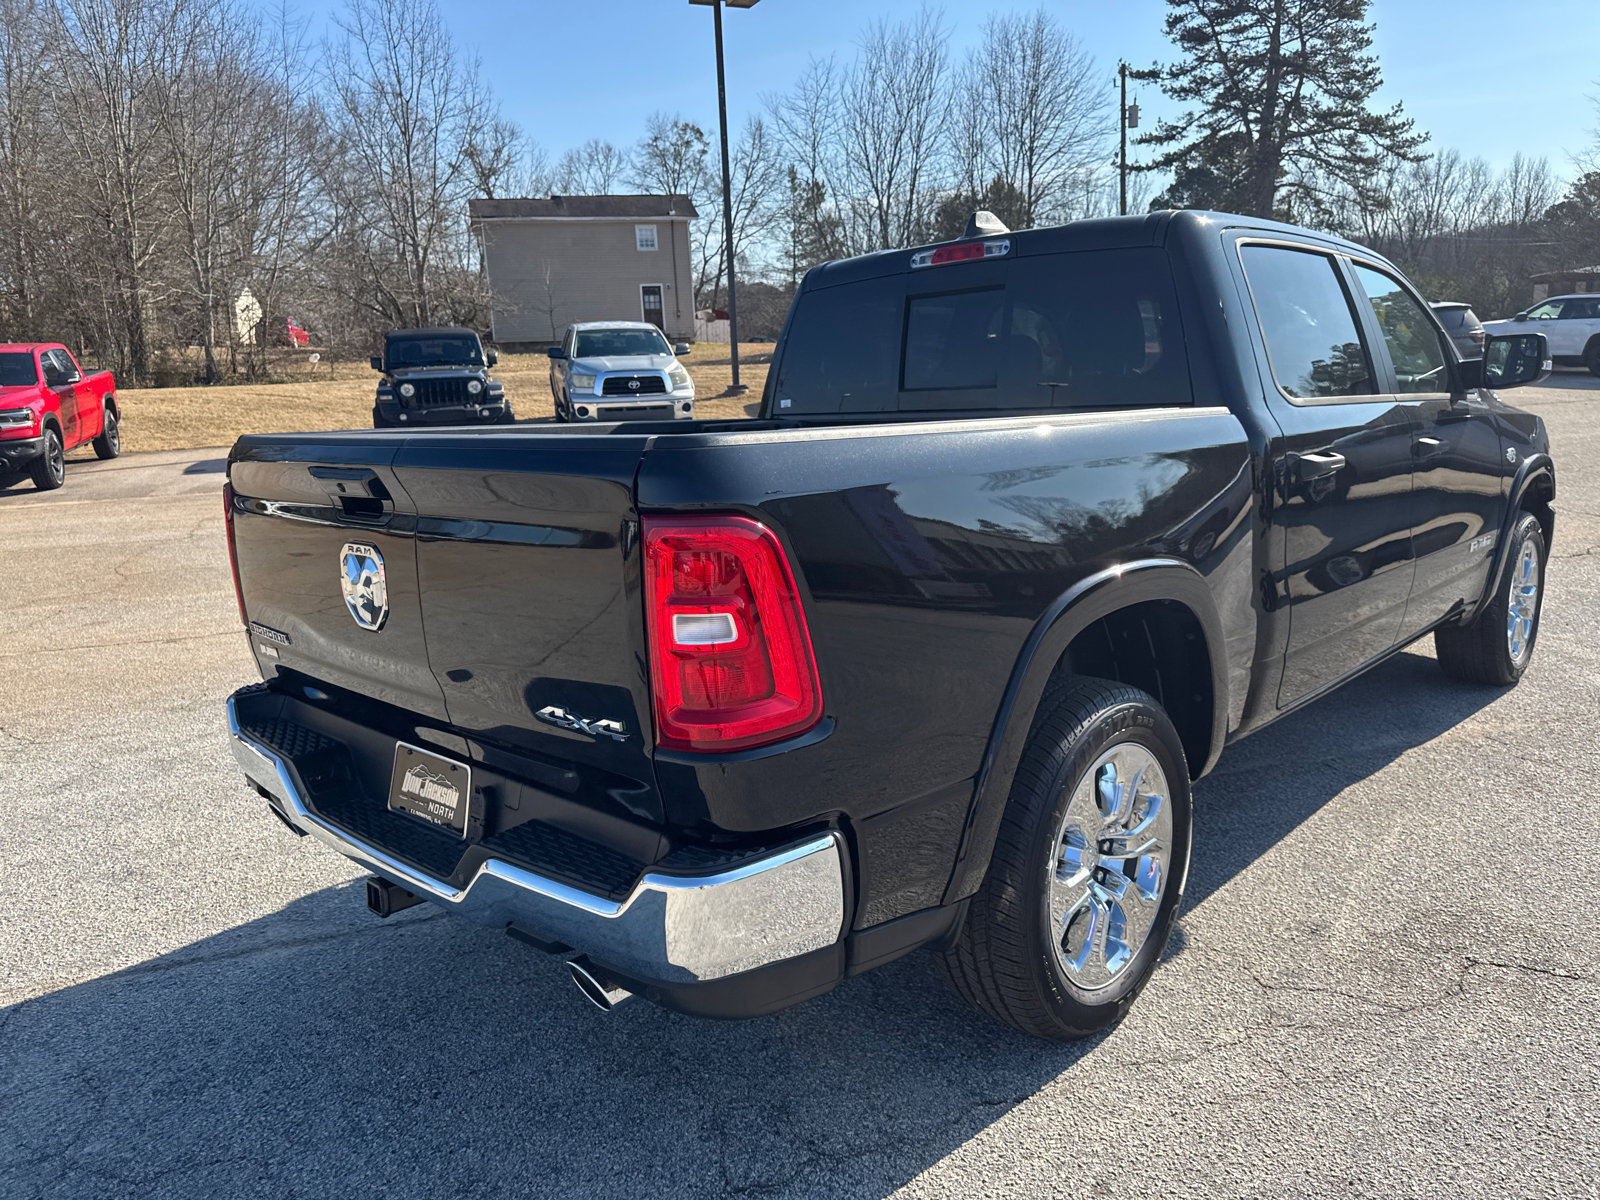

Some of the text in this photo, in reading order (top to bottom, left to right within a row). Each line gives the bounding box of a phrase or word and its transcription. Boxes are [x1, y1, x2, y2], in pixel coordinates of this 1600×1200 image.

[347, 545, 372, 556] RAM
[401, 771, 422, 795] DON
[420, 779, 460, 809] JACKSON
[427, 801, 455, 820] NORTH
